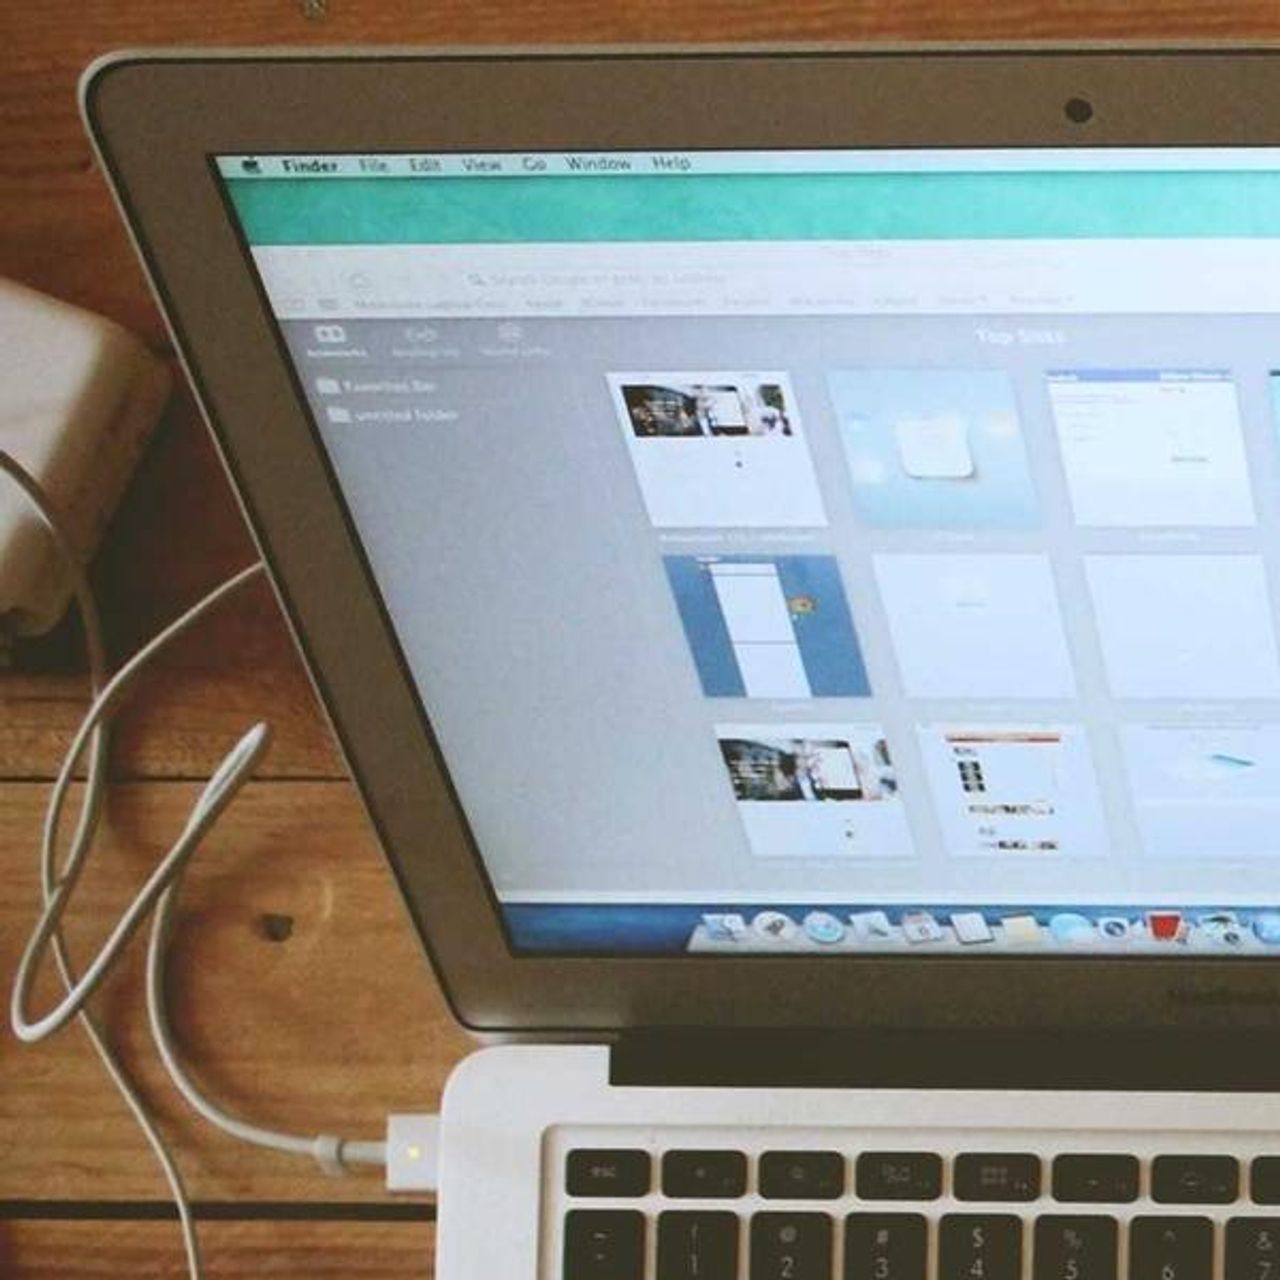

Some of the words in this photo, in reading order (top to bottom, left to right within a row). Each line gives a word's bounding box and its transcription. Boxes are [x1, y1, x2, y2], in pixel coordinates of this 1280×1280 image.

[282, 158, 339, 174] Finder
[358, 158, 389, 173] File
[409, 157, 442, 173] Edit
[461, 157, 502, 172] View
[521, 157, 547, 172] Go
[564, 156, 633, 172] Window
[651, 156, 692, 173] Help
[781, 1255, 794, 1278] 2
[875, 1257, 889, 1279] 3
[970, 1258, 984, 1278] 4
[1064, 1259, 1079, 1280] 5
[1258, 1260, 1272, 1280] 7
